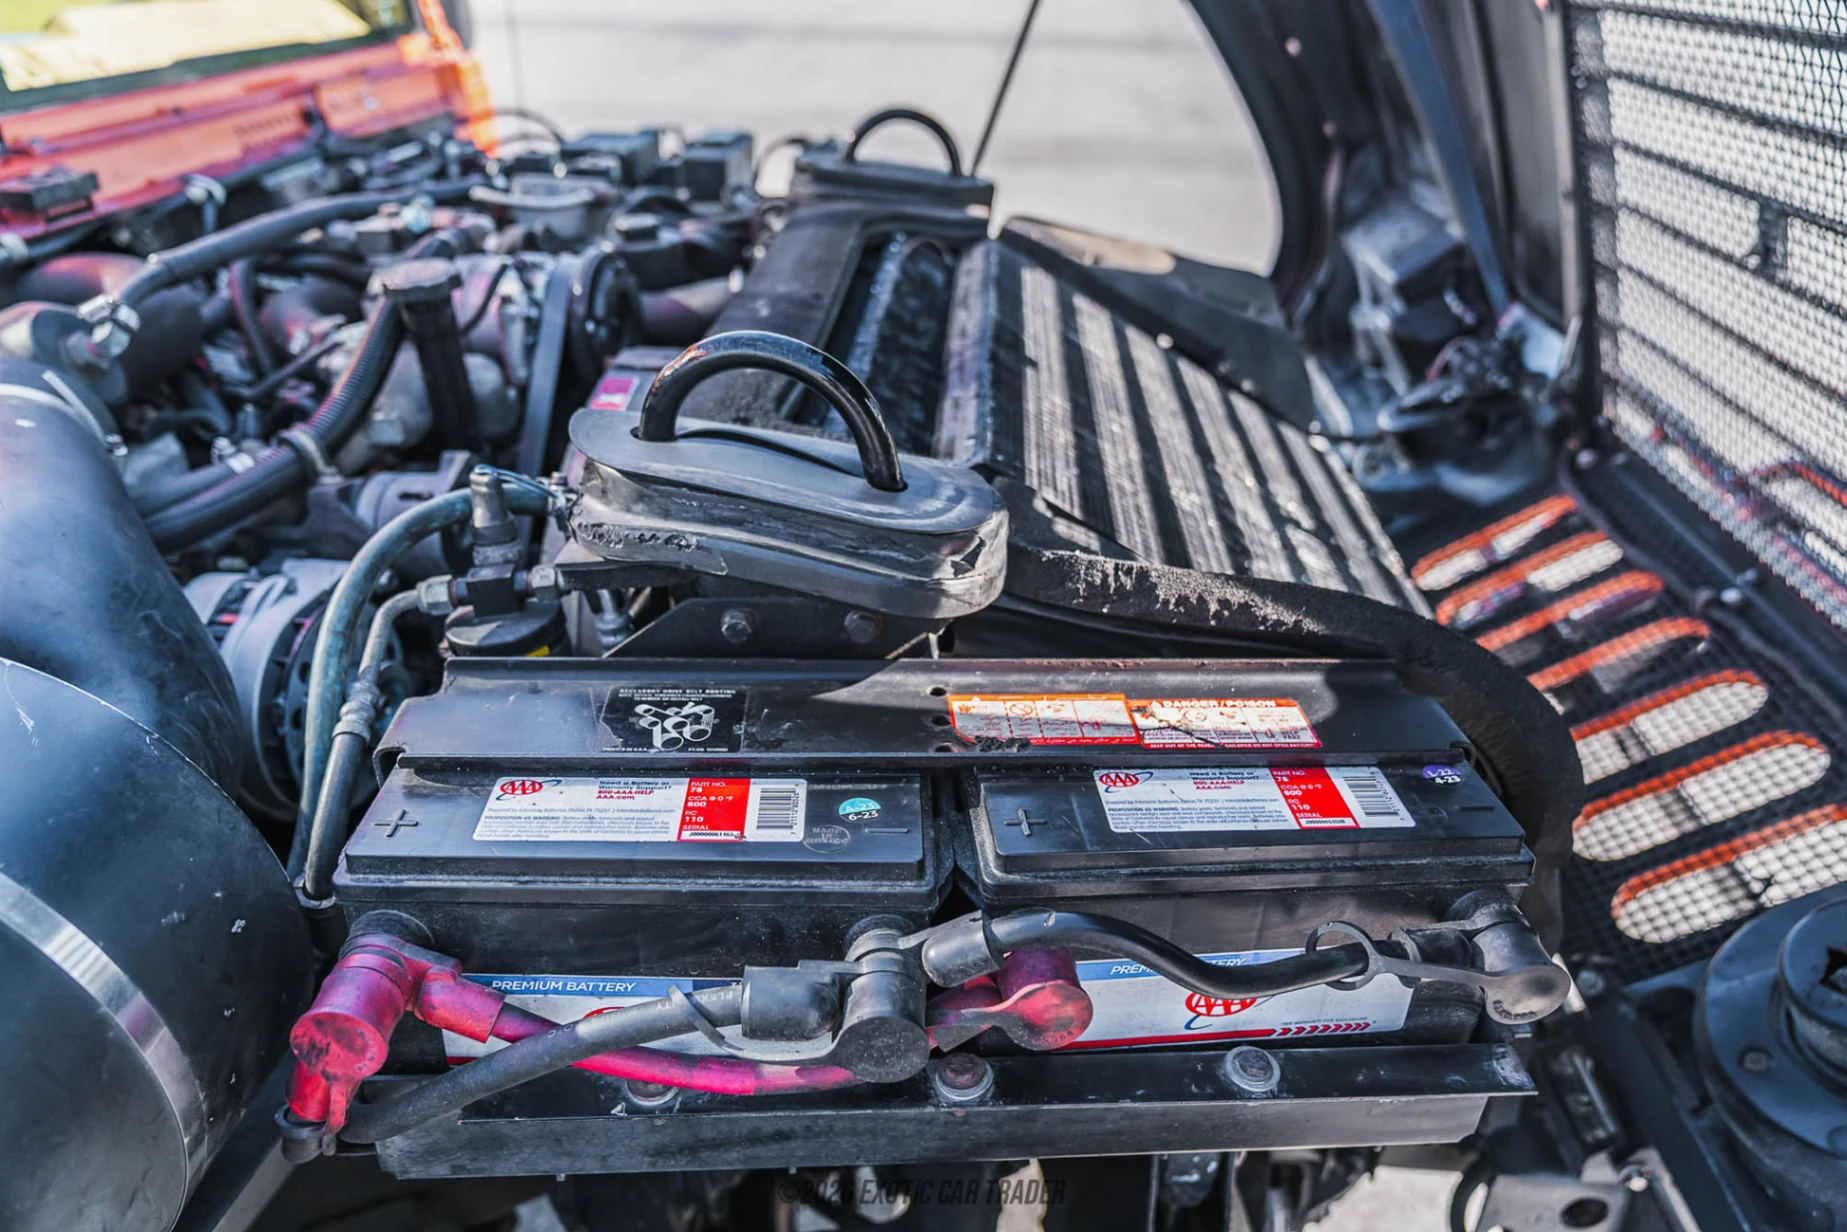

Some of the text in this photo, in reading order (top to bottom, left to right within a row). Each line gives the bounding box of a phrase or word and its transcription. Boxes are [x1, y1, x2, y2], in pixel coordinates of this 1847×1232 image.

[1165, 700, 1220, 708] DANGER
[1226, 700, 1277, 708] POISON
[1100, 773, 1138, 787] AAA
[502, 781, 542, 795] AAA
[845, 802, 875, 813] A-23
[848, 810, 879, 821] 6-23
[492, 980, 636, 992] PREMIUM BATTERY
